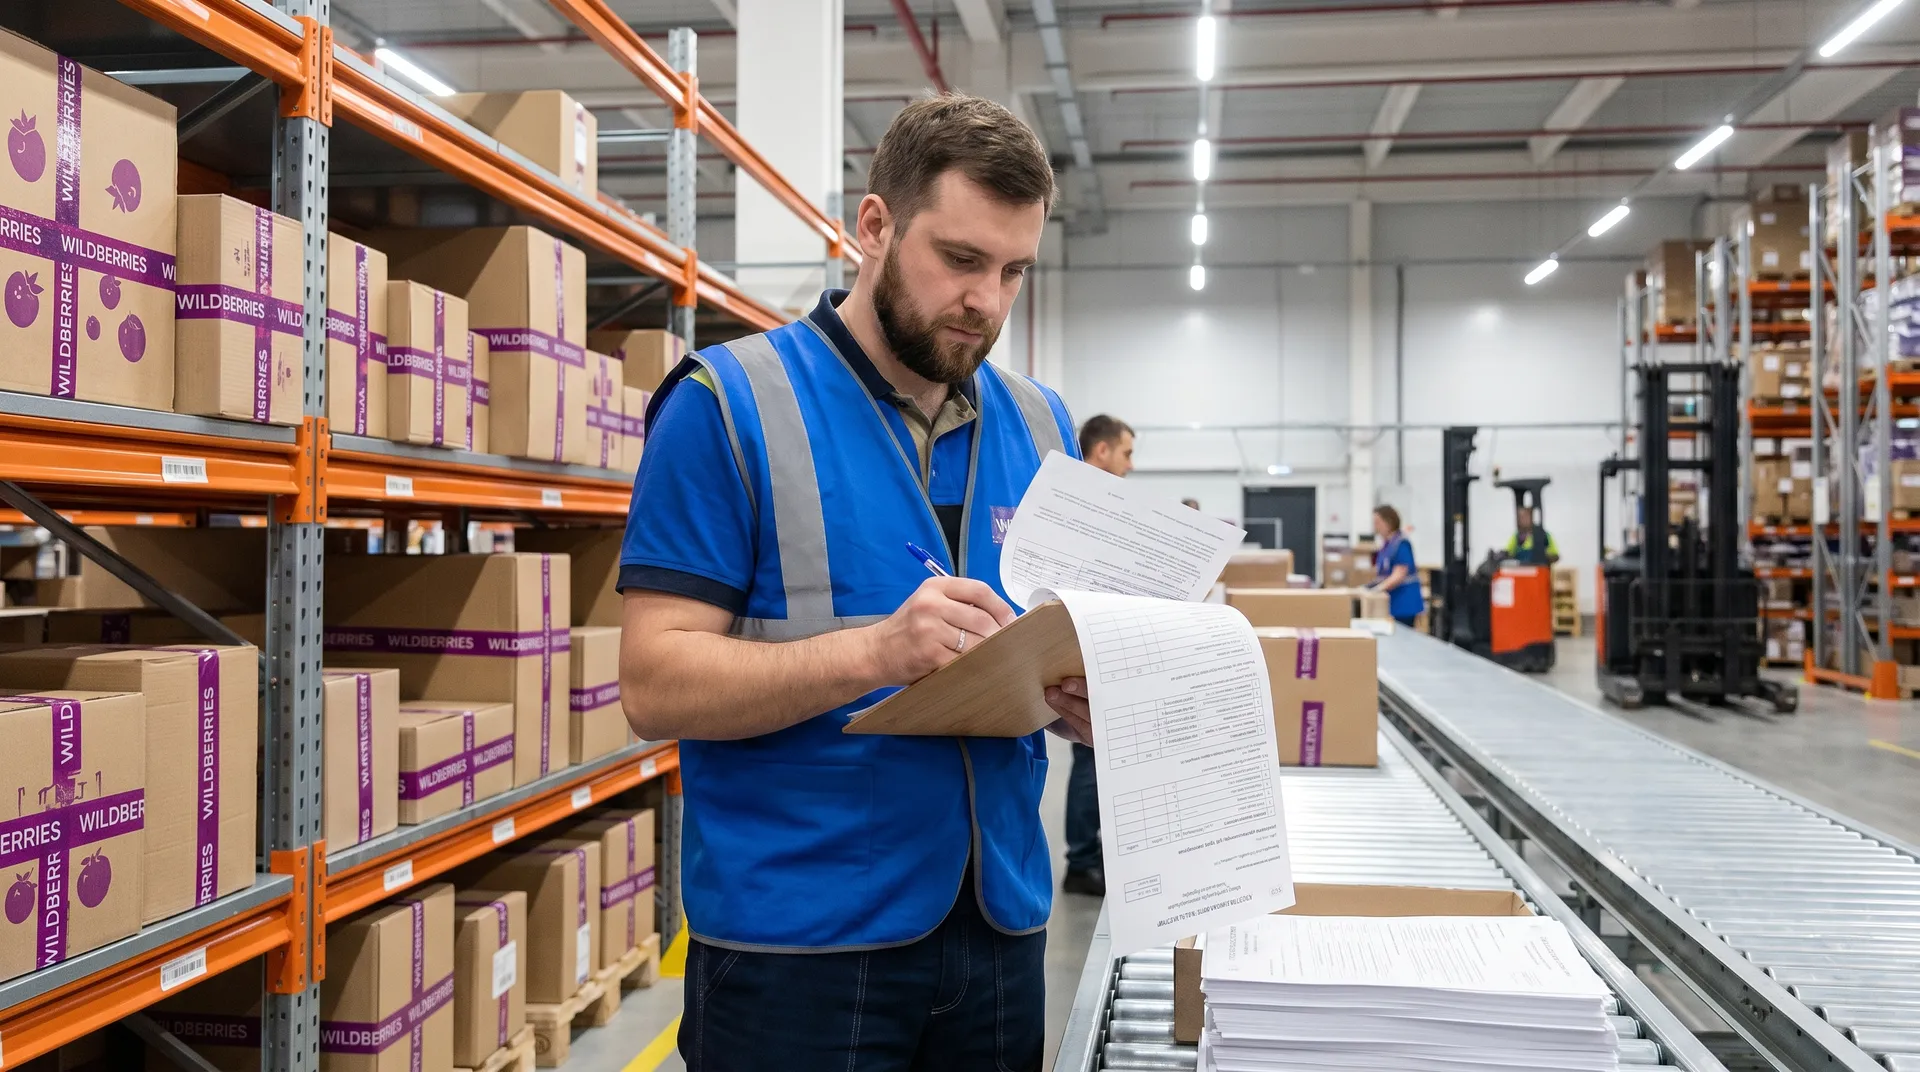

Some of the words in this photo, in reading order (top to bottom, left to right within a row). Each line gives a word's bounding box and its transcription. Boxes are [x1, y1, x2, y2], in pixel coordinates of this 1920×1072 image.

[61, 233, 148, 274] WILDBERRIES
[177, 293, 265, 319] WILDBERRIES
[388, 635, 475, 650] WILDBERRIES
[203, 686, 214, 821] WILDBERRIES
